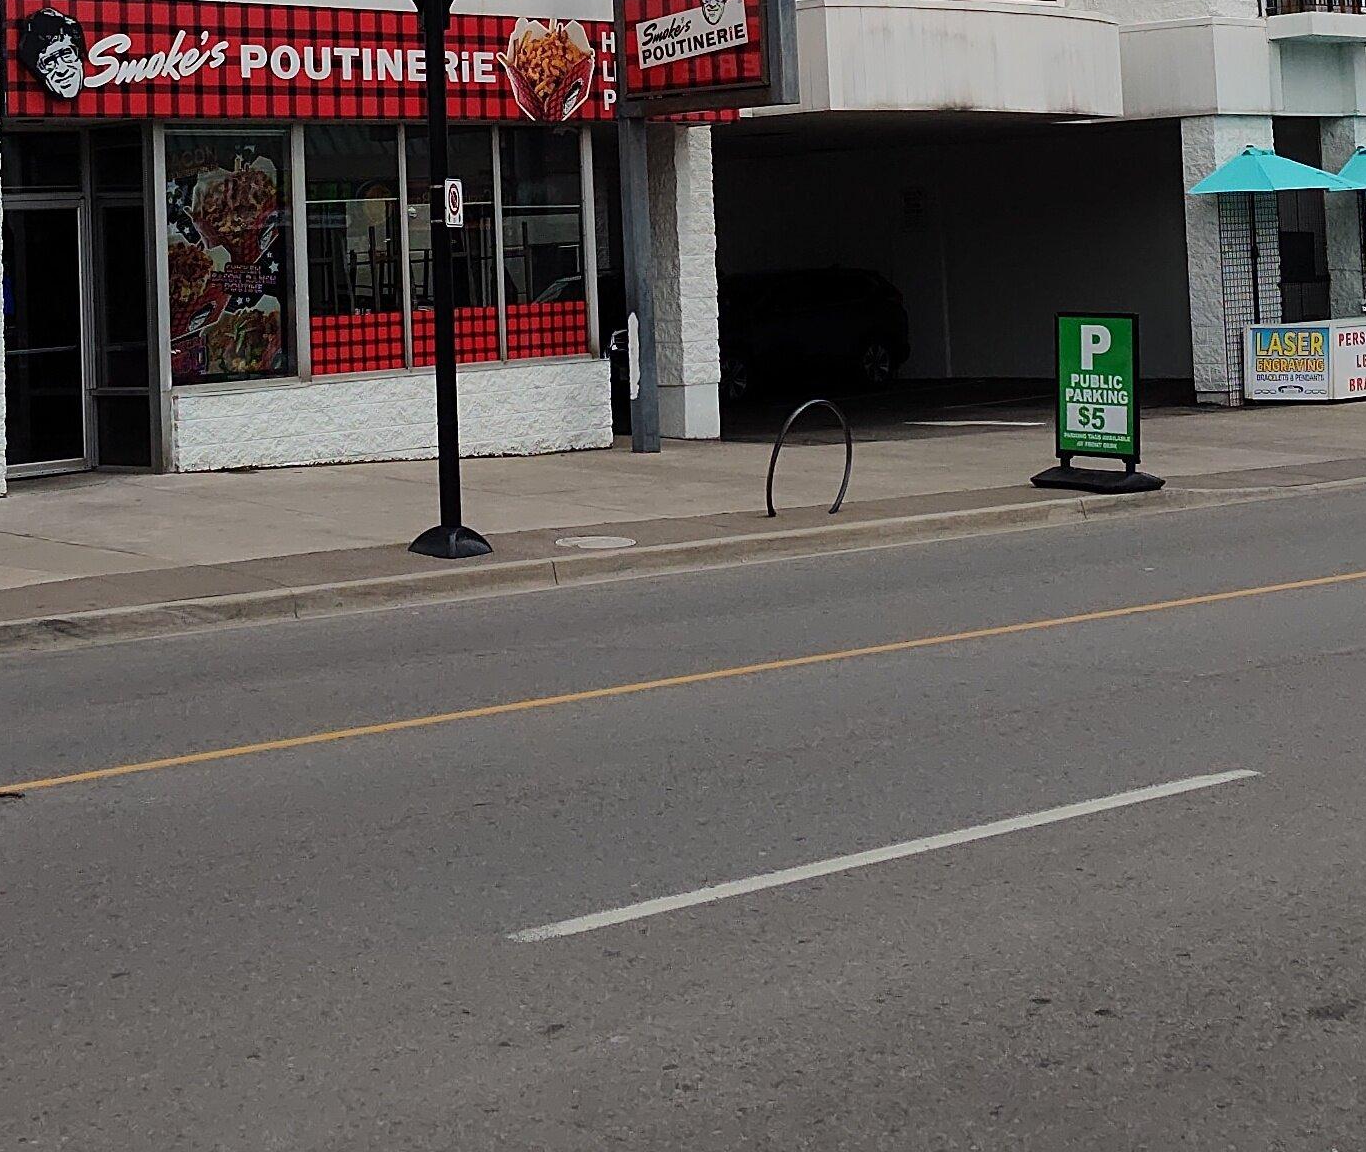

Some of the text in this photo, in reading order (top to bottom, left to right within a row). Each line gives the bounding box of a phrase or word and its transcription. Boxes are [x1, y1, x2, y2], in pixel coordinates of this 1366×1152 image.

[641, 16, 692, 47] Smoke's
[85, 29, 230, 88] Smoke's
[1081, 325, 1112, 371] P
[1255, 332, 1325, 357] LASER
[1255, 358, 1325, 372] ENGRAVING
[1071, 374, 1123, 389] PUBLIC
[1065, 388, 1129, 405] PARKING
[1078, 405, 1105, 431] $5
